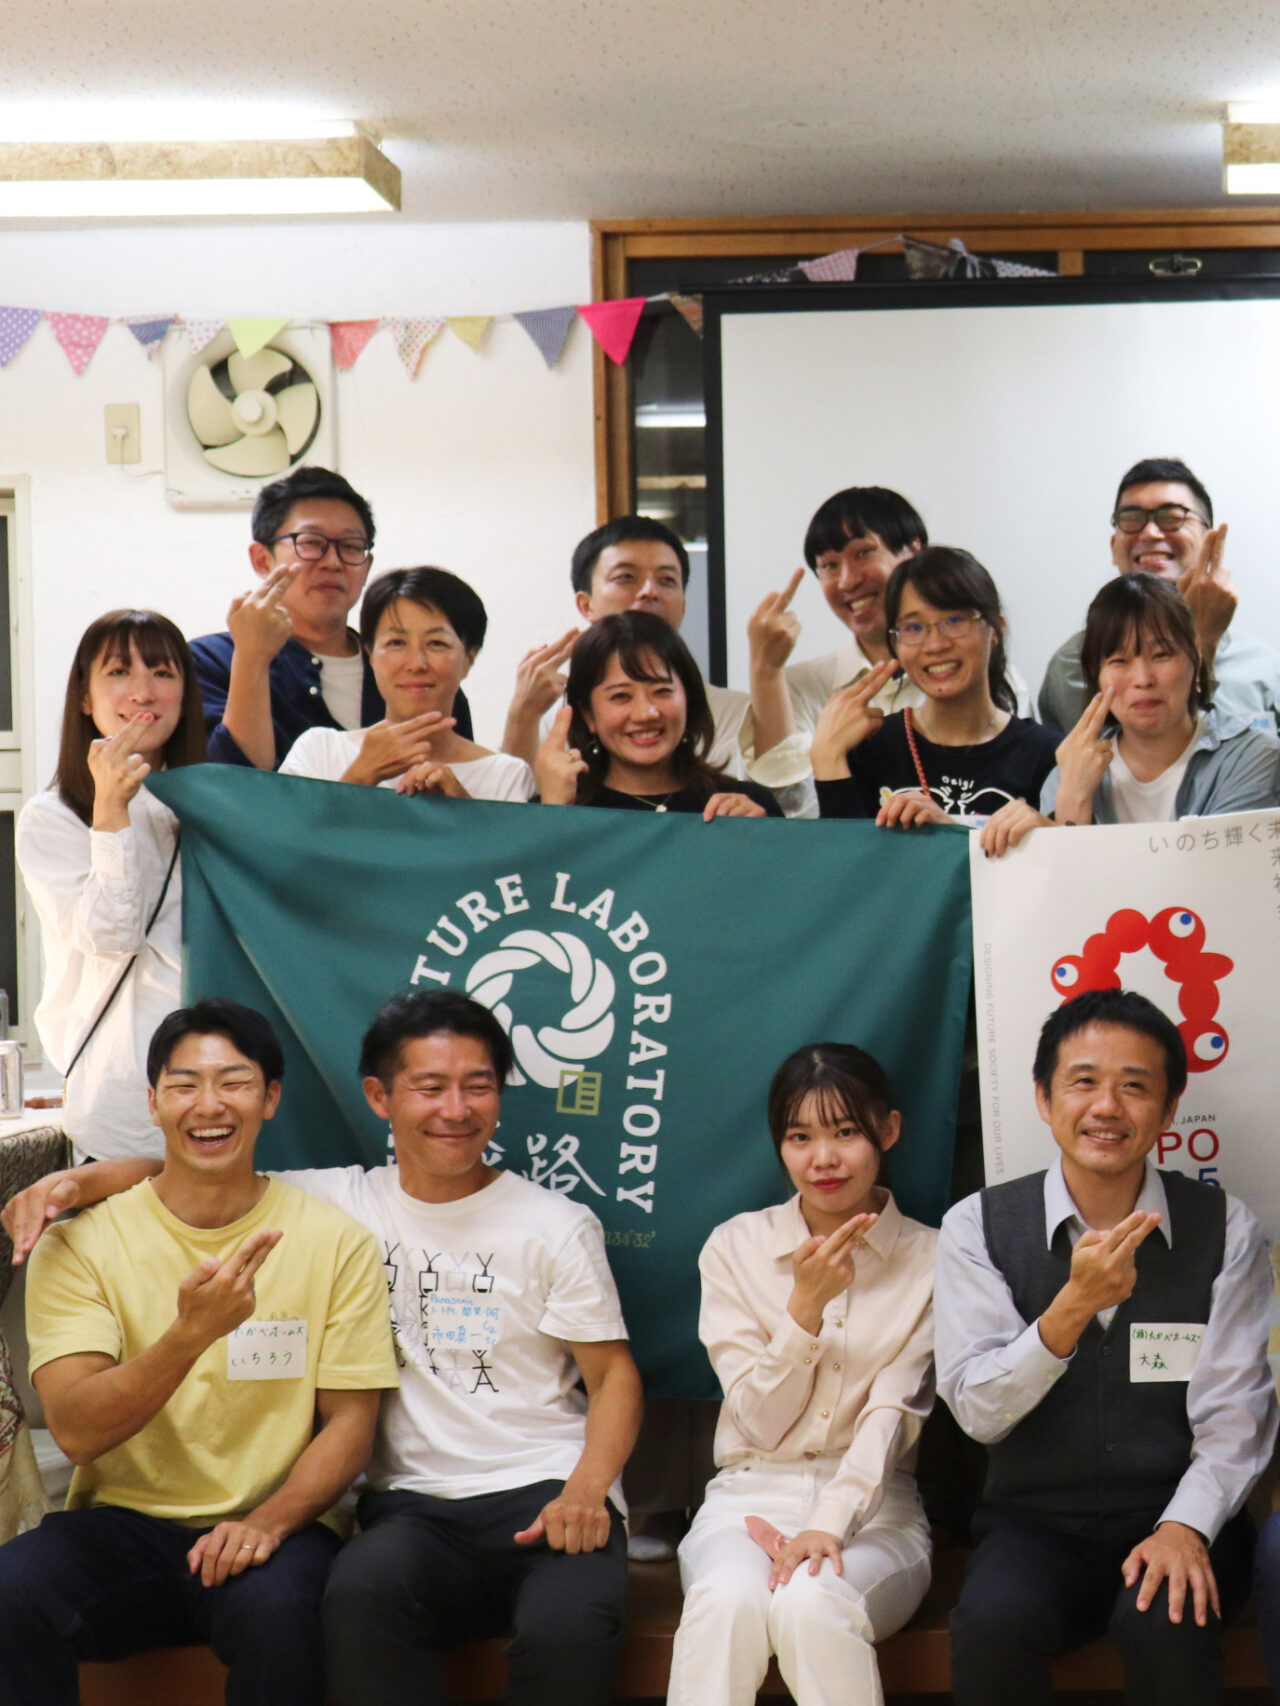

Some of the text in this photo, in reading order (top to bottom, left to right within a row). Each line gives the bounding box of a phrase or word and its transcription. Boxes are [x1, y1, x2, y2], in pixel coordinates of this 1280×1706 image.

[1149, 822, 1262, 854] いのち輝く
[409, 872, 672, 1213] TURE LABORATORY
[983, 942, 1004, 1176] DESIGNING FUTURE SOCIETY FOR OUR LIVES
[1181, 1114, 1216, 1125] JAPAN
[1156, 1128, 1219, 1165] PO
[1139, 1352, 1169, 1370] 大森
